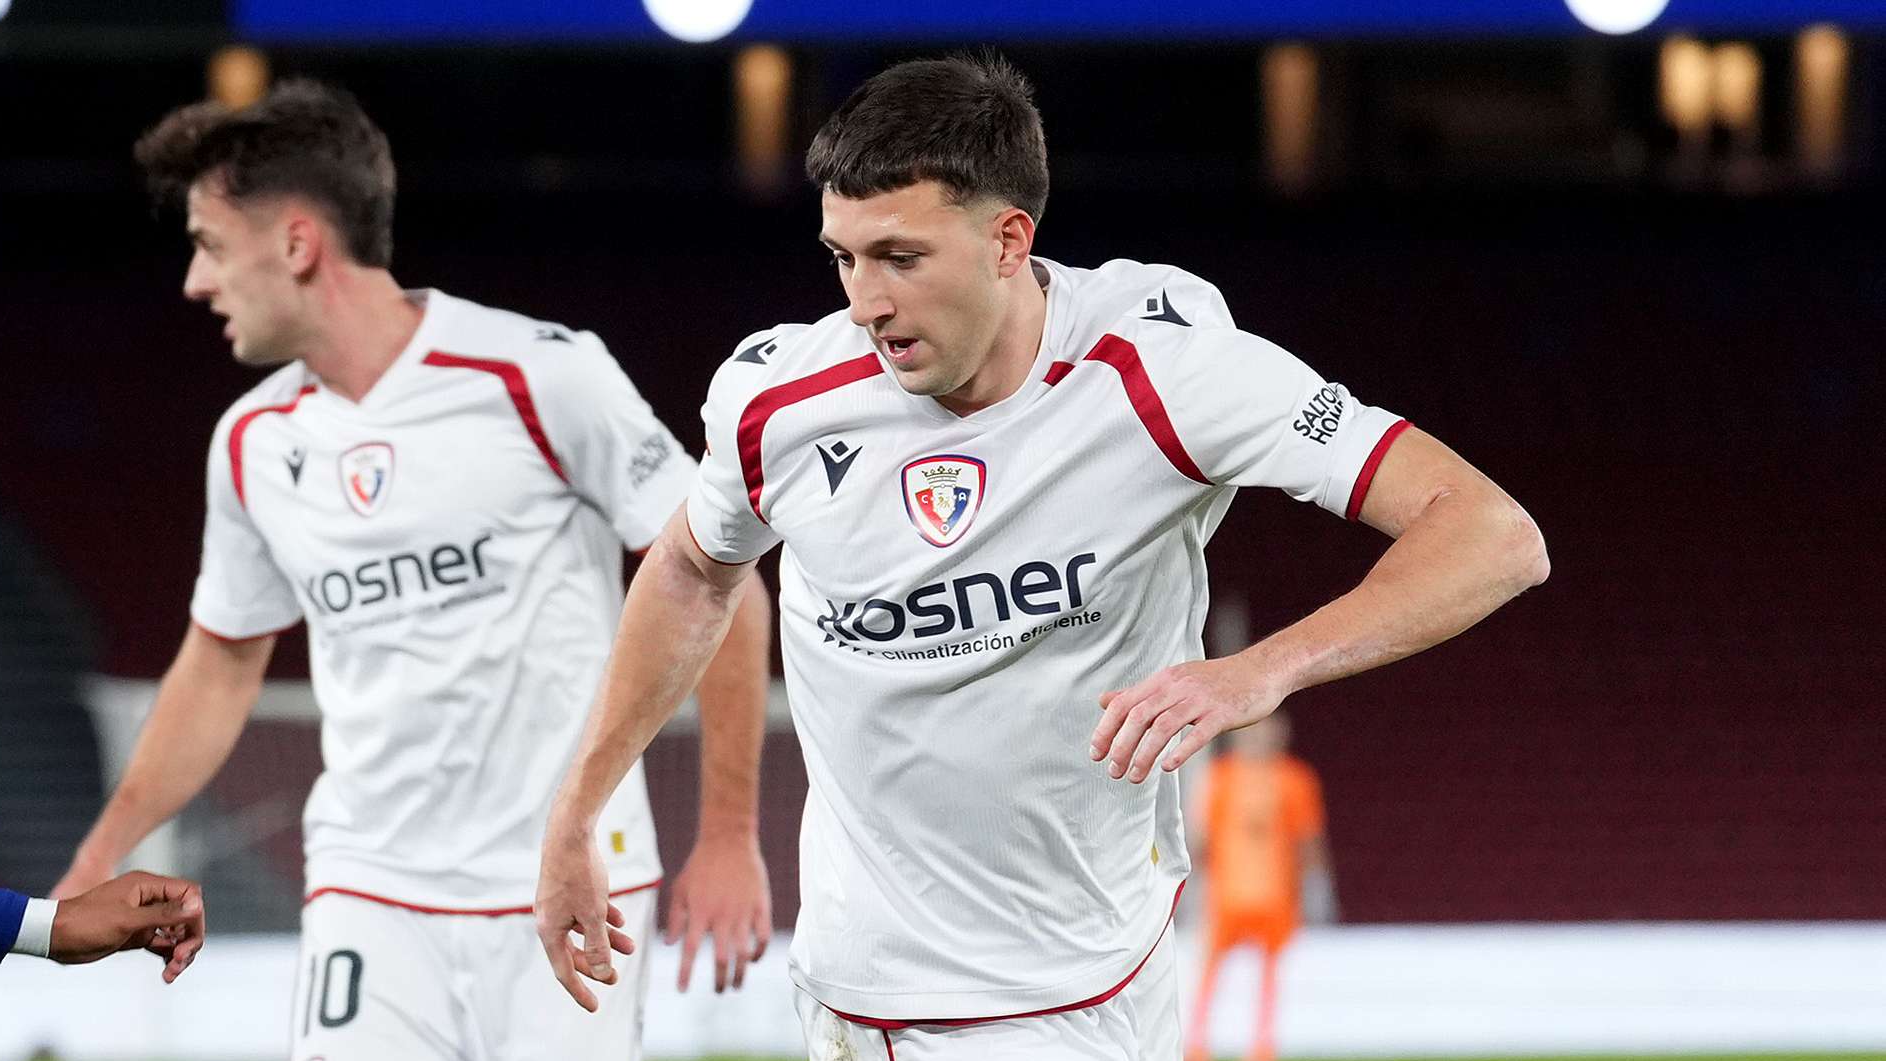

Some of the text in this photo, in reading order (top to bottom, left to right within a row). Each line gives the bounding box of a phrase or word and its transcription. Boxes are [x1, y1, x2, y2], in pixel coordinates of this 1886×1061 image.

[1293, 383, 1340, 437] SALTO
[817, 552, 1096, 642] kosner
[882, 610, 1102, 661] Climatización eficiente
[303, 950, 363, 1038] 10
